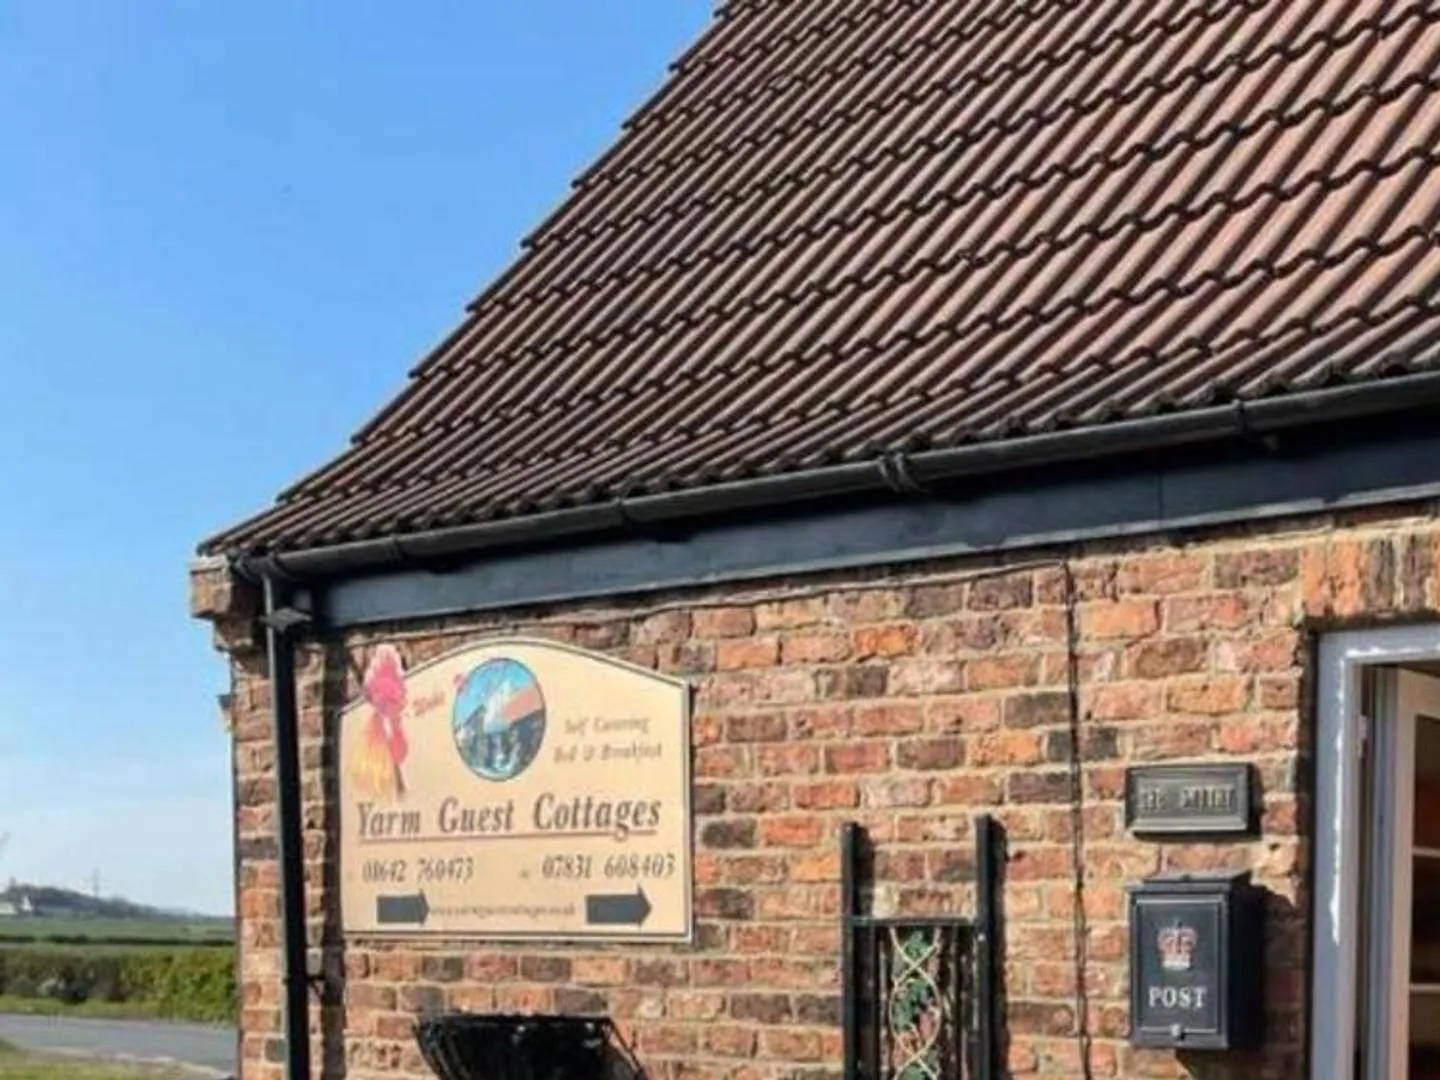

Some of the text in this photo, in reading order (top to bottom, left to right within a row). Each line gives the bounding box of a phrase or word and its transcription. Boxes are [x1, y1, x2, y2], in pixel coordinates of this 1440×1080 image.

[357, 791, 661, 843] Yarm Guest Cottages
[362, 859, 407, 883] 01642
[541, 853, 592, 879] 07831
[603, 852, 676, 879] 608403
[1147, 986, 1207, 1008] POST
